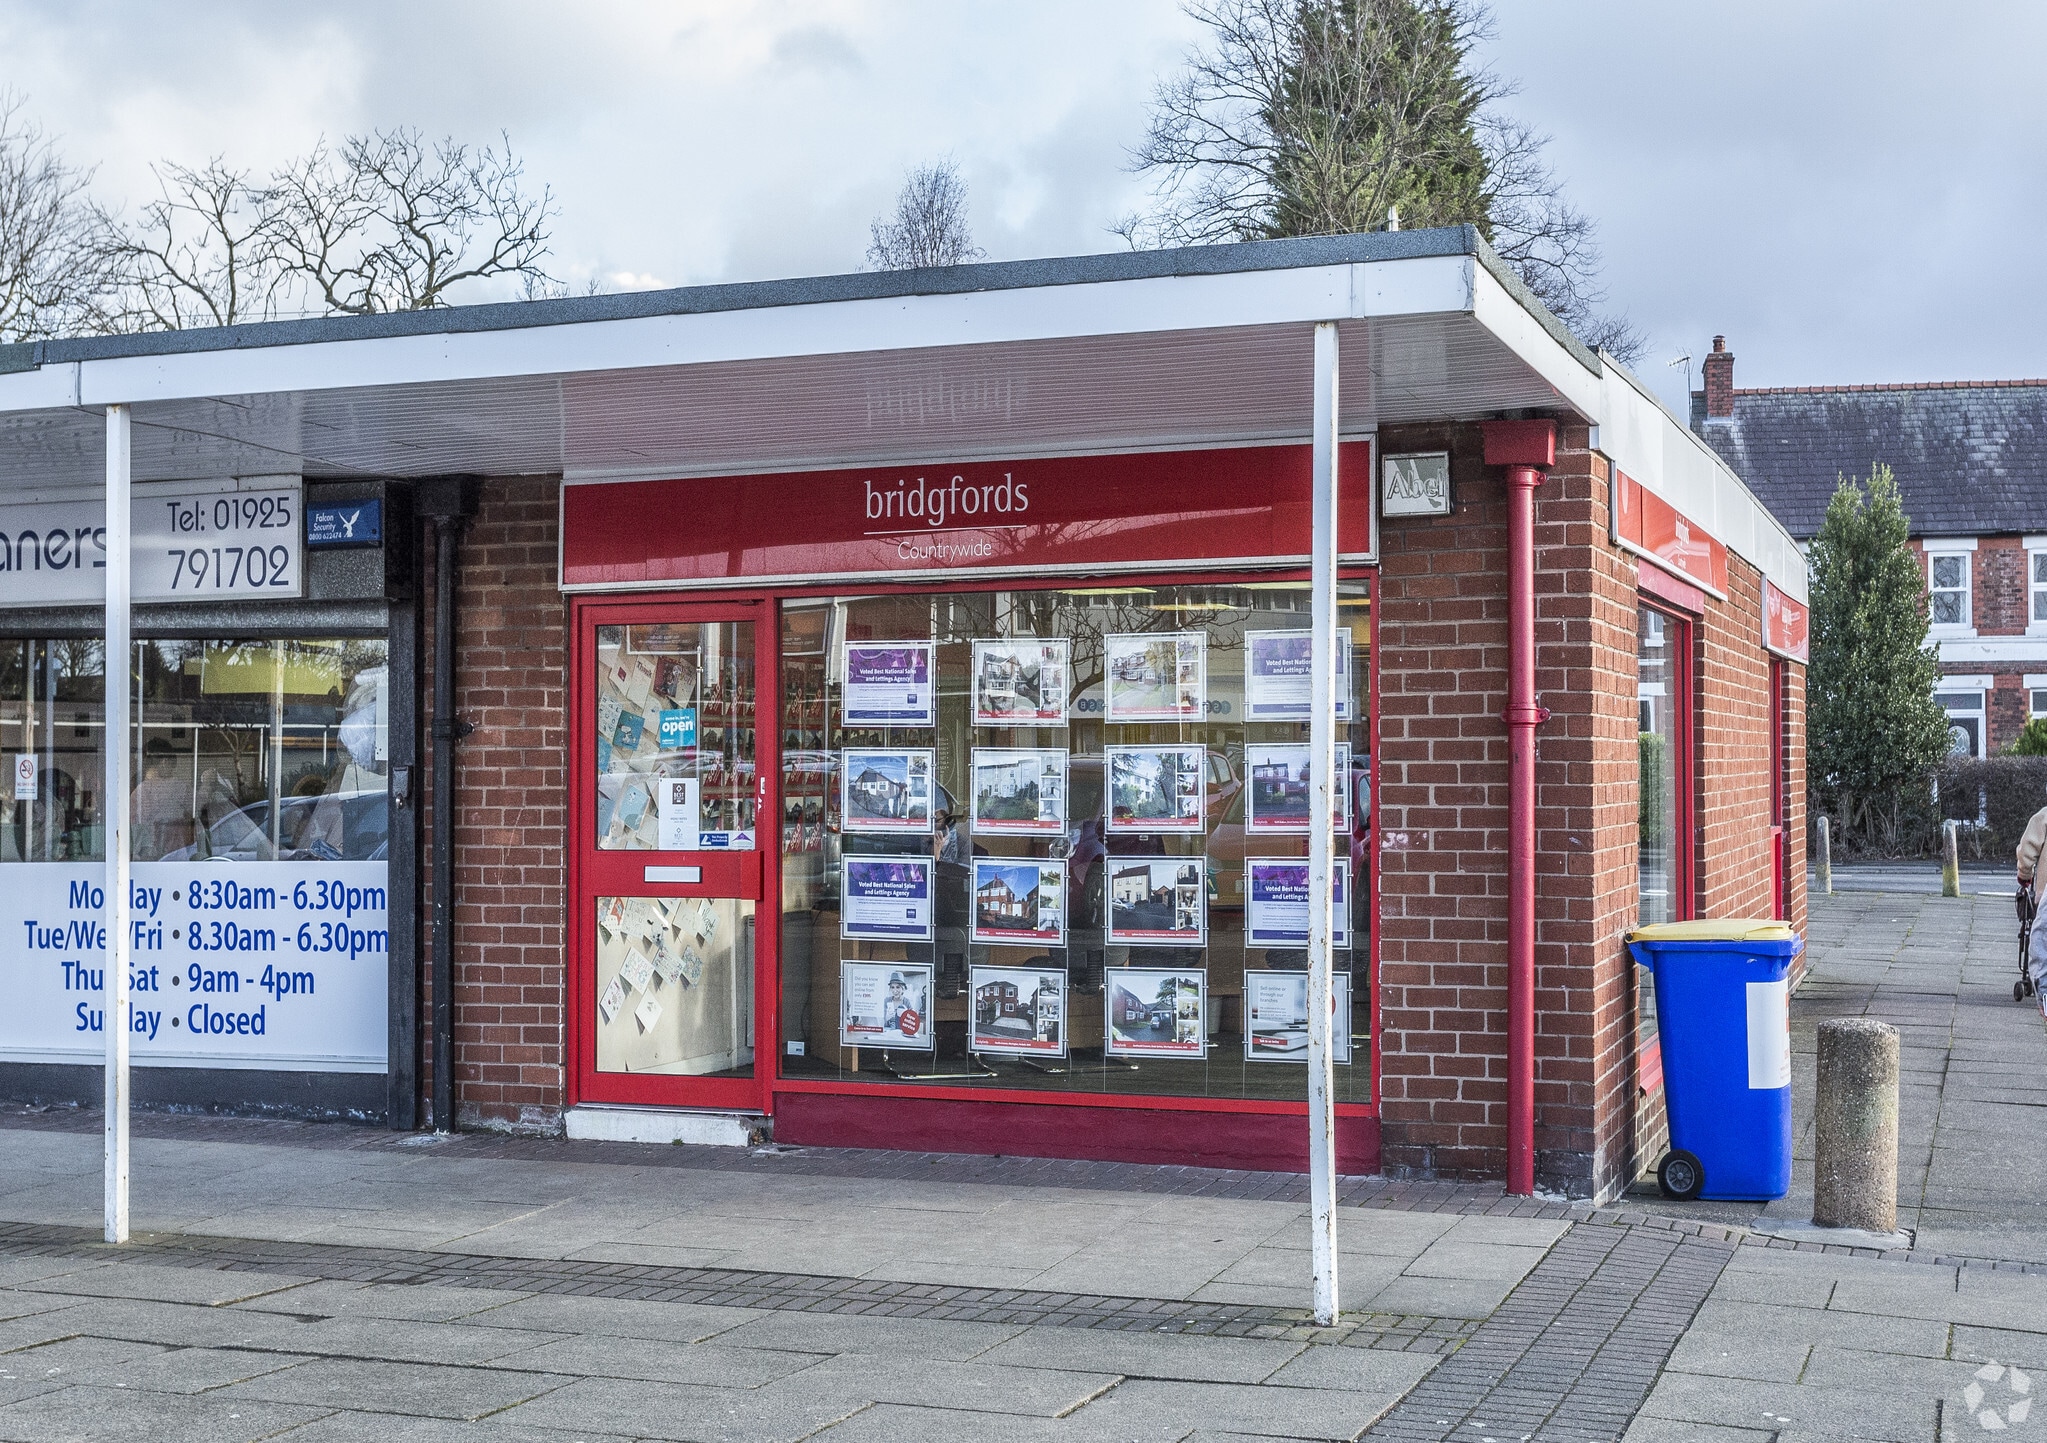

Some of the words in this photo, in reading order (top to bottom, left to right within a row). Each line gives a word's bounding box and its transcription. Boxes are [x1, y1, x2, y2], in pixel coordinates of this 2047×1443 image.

[167, 500, 206, 533] Tel:
[213, 496, 291, 530] 01925
[315, 512, 334, 522] Falcon
[864, 472, 1029, 526] bridgfords
[313, 522, 336, 532] Security
[168, 545, 289, 589] 791702
[897, 538, 992, 562] Countrywide
[662, 720, 693, 735] open
[188, 880, 276, 910] 8:30am
[292, 880, 386, 918] 6.30pm
[188, 922, 276, 952] 8.30am
[296, 922, 388, 960] 6.30pm
[188, 962, 239, 993] 9am
[260, 964, 315, 1002] 4pm
[188, 1004, 266, 1035] Closed
